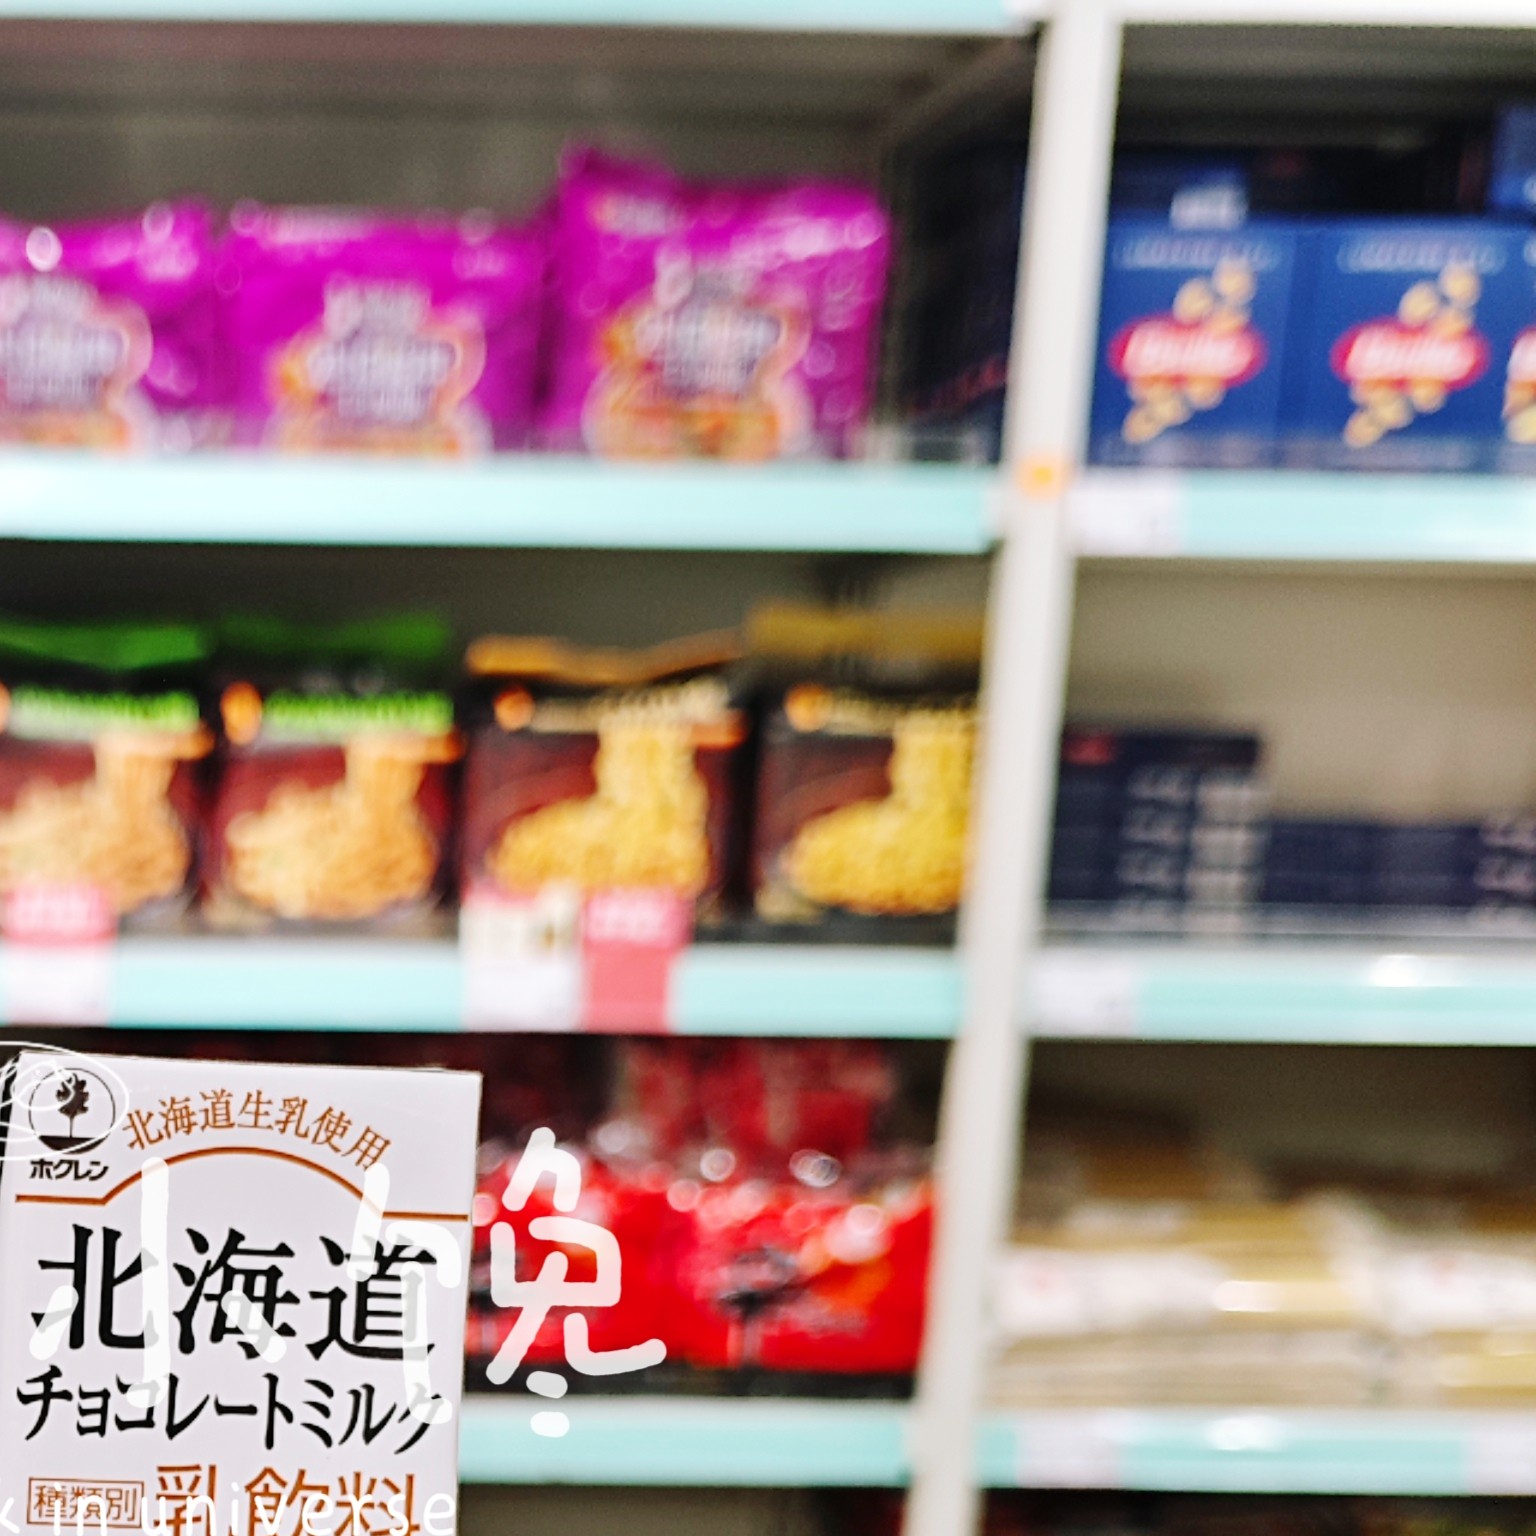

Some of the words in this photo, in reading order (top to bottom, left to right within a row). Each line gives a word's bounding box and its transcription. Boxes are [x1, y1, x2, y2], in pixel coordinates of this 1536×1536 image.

[30, 1158, 110, 1182] ホクレン
[122, 1089, 392, 1172] 北海道生乳使用
[30, 1223, 438, 1362] 北海道
[16, 1364, 442, 1455] チョコレートミルク
[32, 1483, 141, 1524] 種類別
